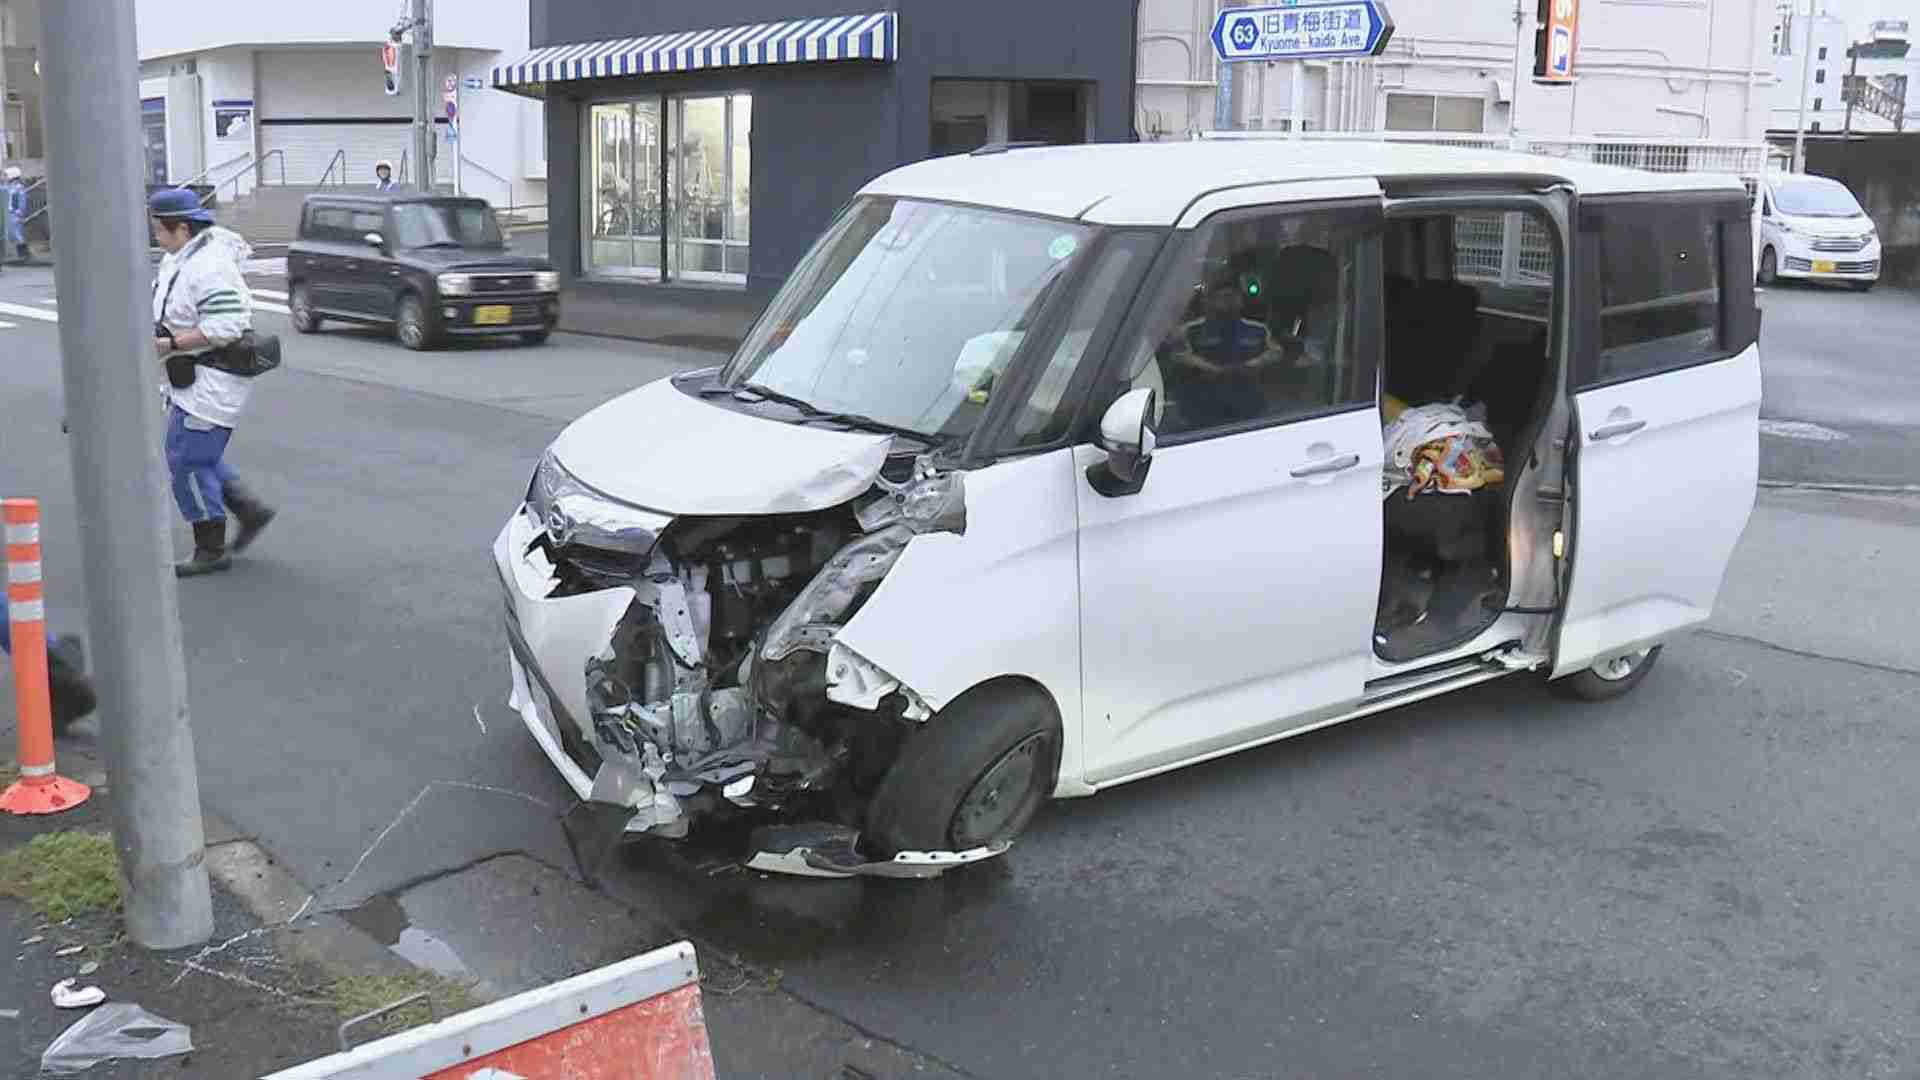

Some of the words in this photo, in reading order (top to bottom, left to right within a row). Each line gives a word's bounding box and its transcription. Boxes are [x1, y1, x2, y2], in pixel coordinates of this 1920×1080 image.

[1262, 9, 1361, 34] 旧青梅街道
[1234, 25, 1254, 43] 63
[1341, 32, 1364, 48] Ave.
